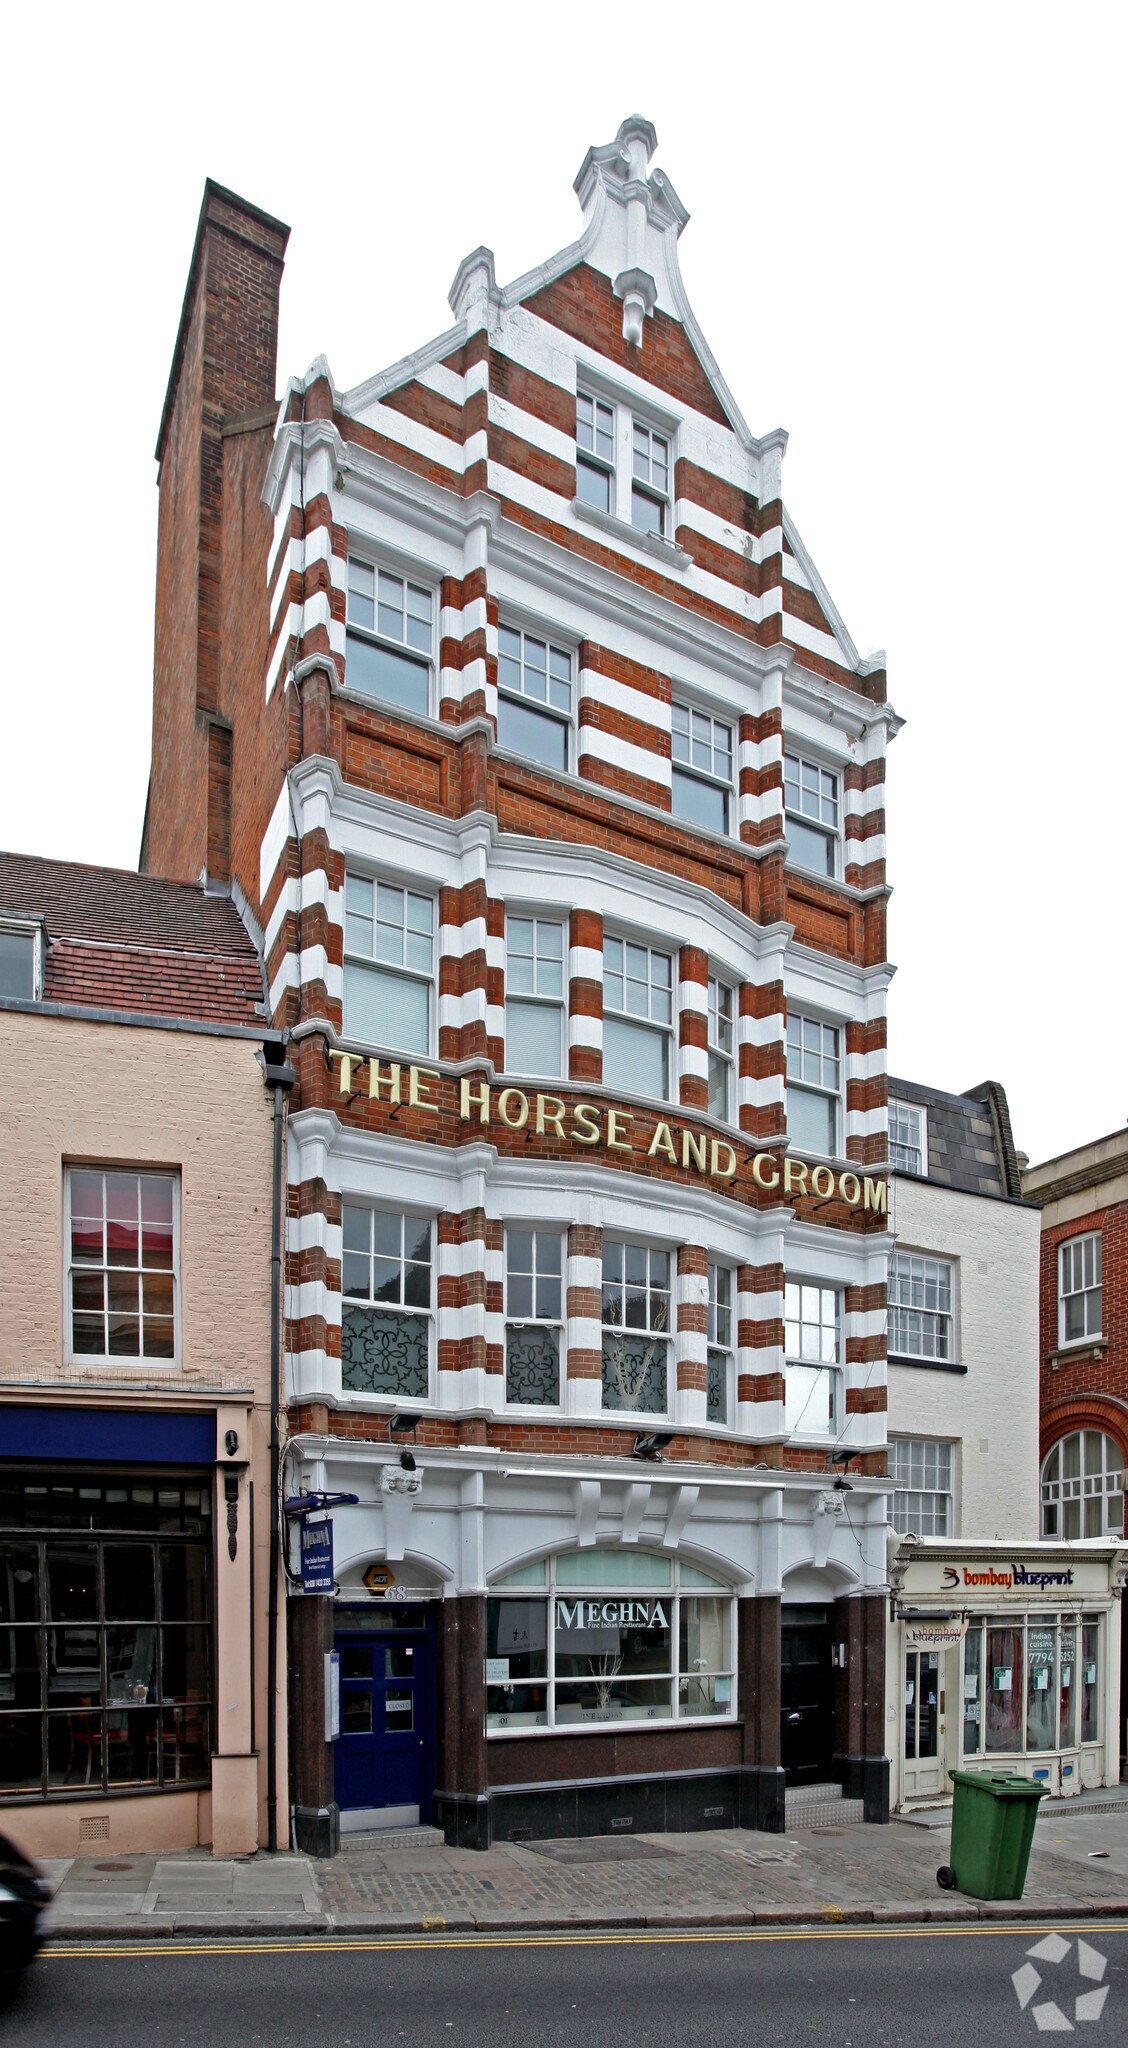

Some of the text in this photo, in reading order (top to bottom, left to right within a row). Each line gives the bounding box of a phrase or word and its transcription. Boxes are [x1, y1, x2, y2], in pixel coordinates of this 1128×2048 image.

[330, 1049, 888, 1214] THE HORSE AND GROOM
[303, 1527, 330, 1550] MEGHNA
[963, 1564, 1074, 1590] bombay blueprint
[384, 1585, 407, 1601] 68
[555, 1600, 670, 1629] MEGHNA
[1029, 1640, 1053, 1648] cuisine
[1028, 1651, 1054, 1663] 7794
[388, 1702, 410, 1710] CLOSED
